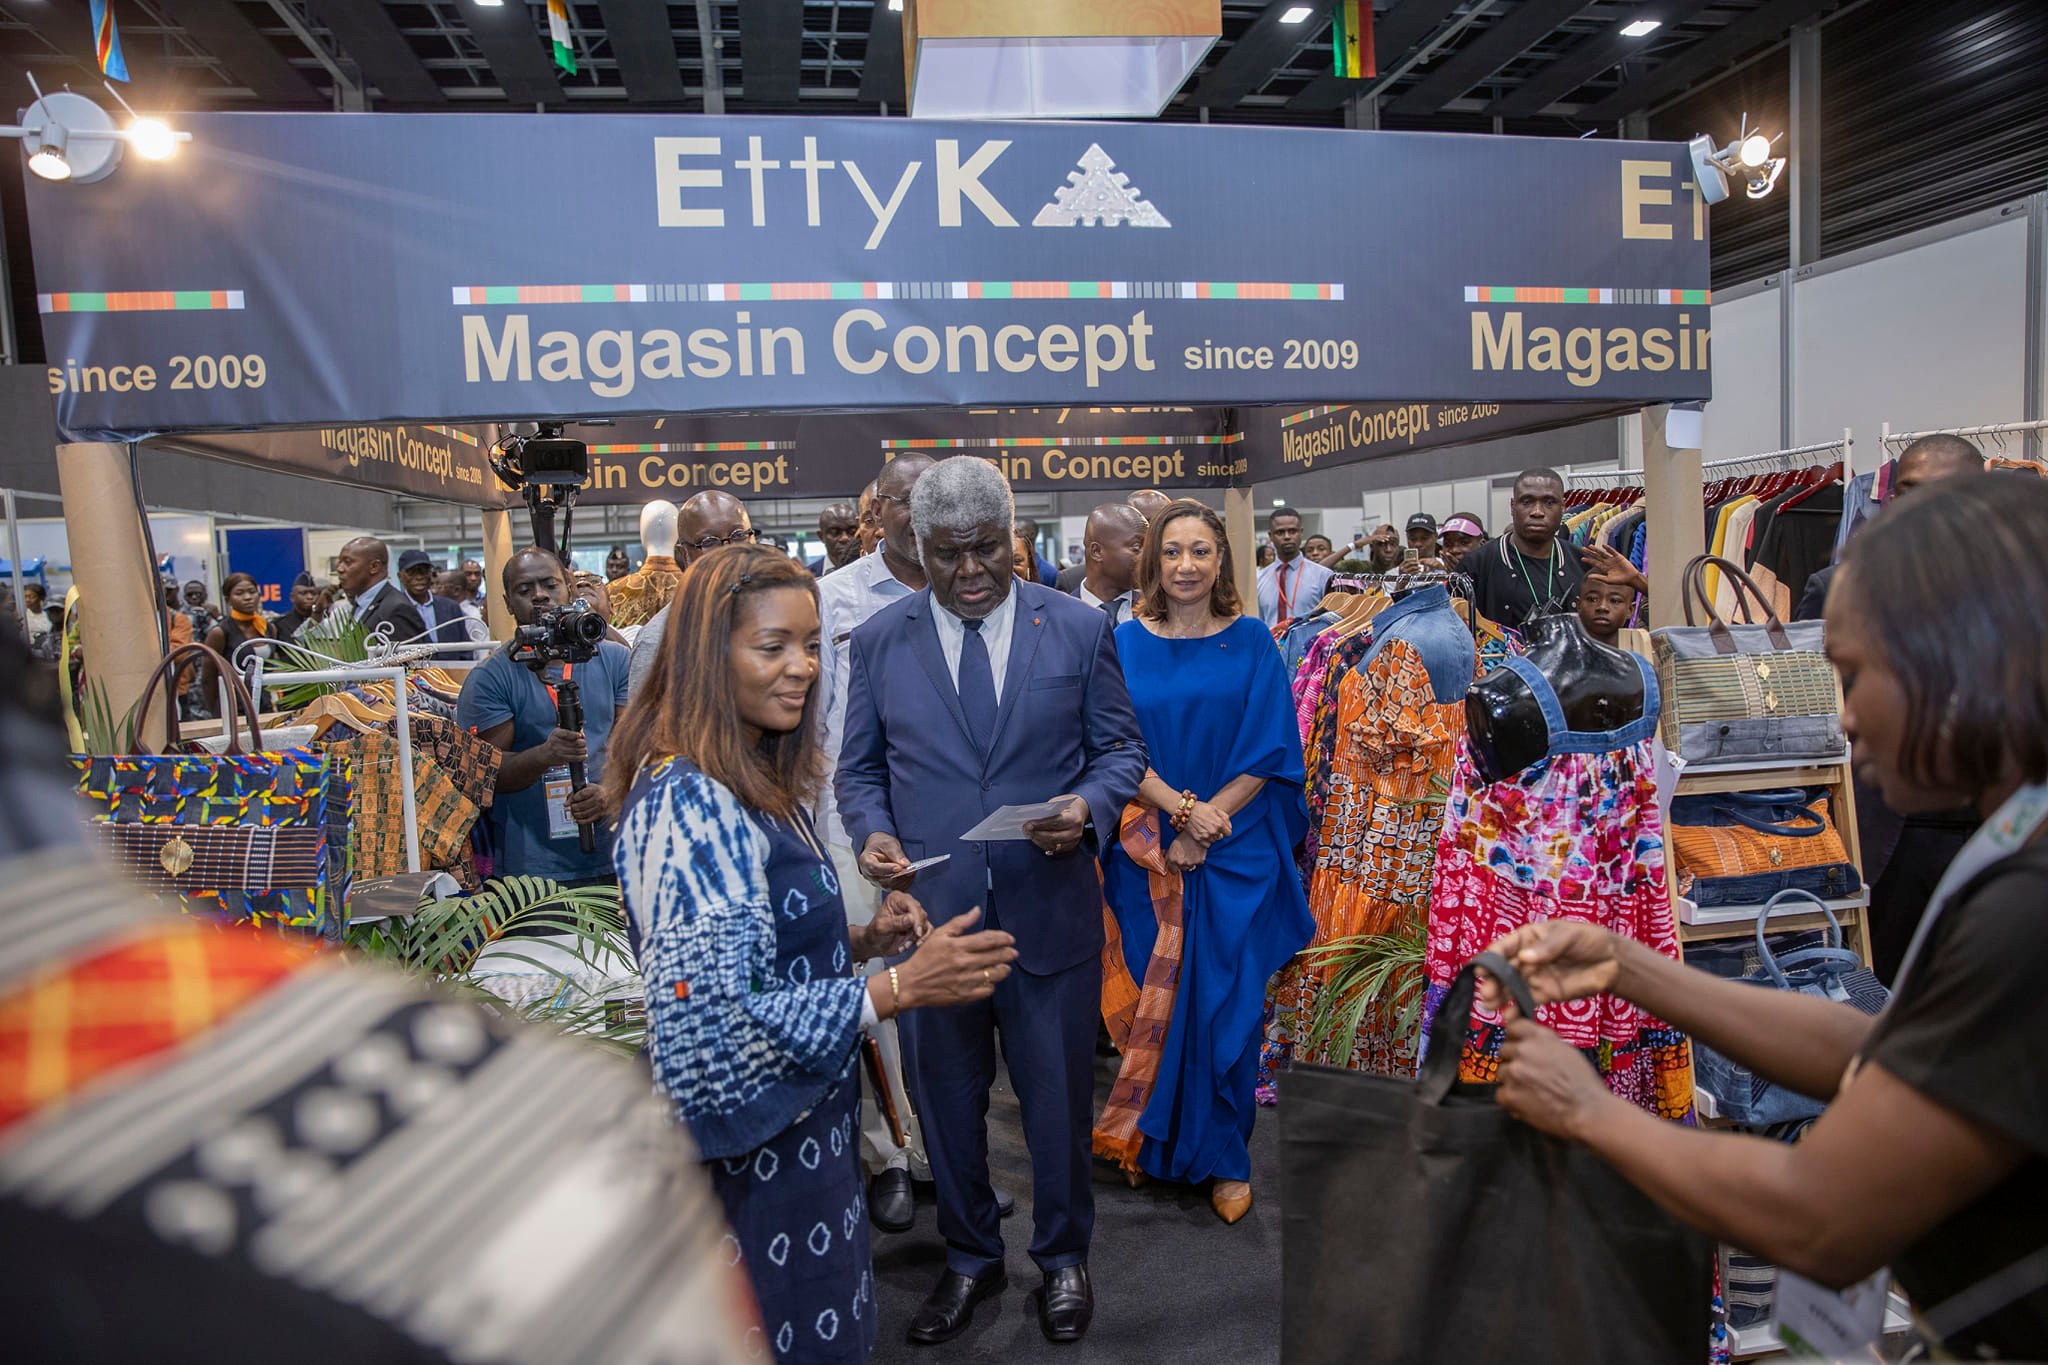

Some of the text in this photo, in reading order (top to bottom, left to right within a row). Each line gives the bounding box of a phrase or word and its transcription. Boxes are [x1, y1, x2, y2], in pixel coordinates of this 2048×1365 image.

[654, 136, 1020, 249] EttyK
[48, 354, 266, 394] since 2009
[462, 309, 1359, 398] Magasin Concept since 2009
[396, 426, 454, 486] Concept
[455, 462, 469, 482] since
[470, 466, 482, 485] 2009
[1042, 447, 1185, 485] Concept
[1197, 461, 1234, 477] since
[1282, 417, 1345, 468] Magasin
[1348, 404, 1431, 445] Concept
[1438, 405, 1468, 428] since
[638, 454, 789, 492] Concept
